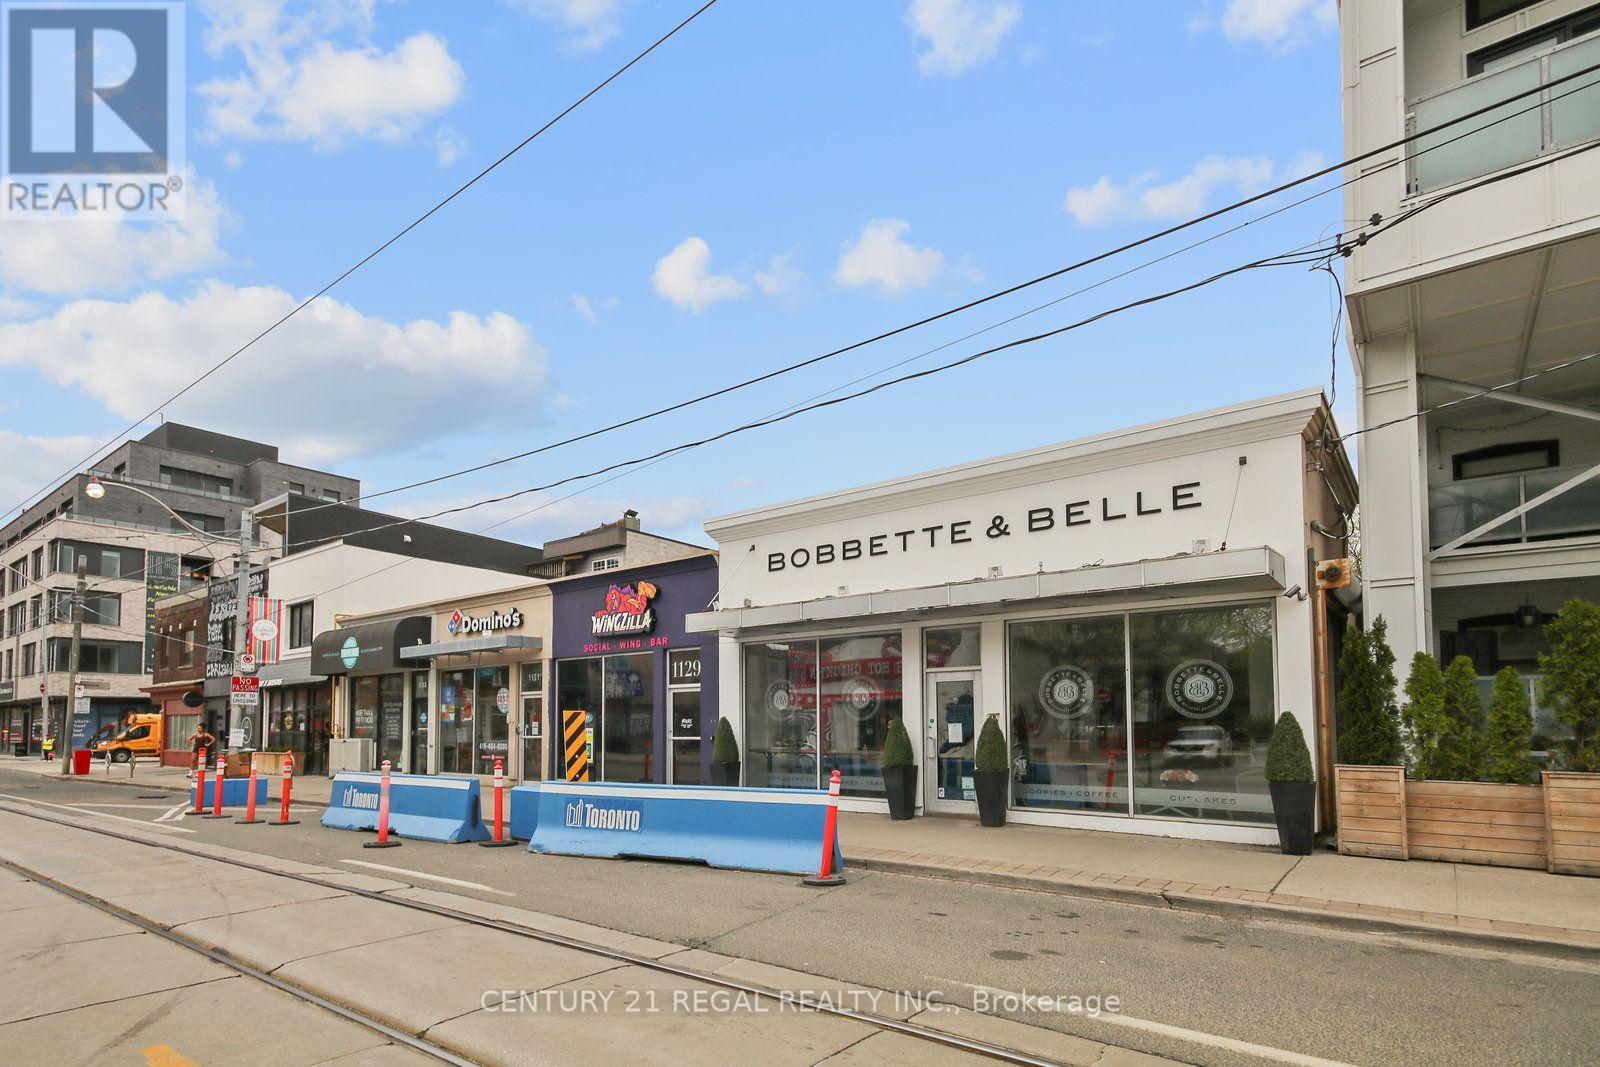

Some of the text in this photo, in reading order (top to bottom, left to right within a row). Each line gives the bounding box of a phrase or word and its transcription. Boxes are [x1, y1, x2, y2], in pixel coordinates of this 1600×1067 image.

[768, 481, 1202, 572] BOBBETTE & BELLE
[461, 607, 520, 633] Domino's
[583, 636, 669, 653] SOCIAL WING BAR
[671, 660, 701, 678] 1129
[232, 684, 259, 692] PASSING
[352, 789, 379, 809] TORONTO
[1076, 790, 1120, 799] COFFEE
[584, 803, 641, 832] TORONTO
